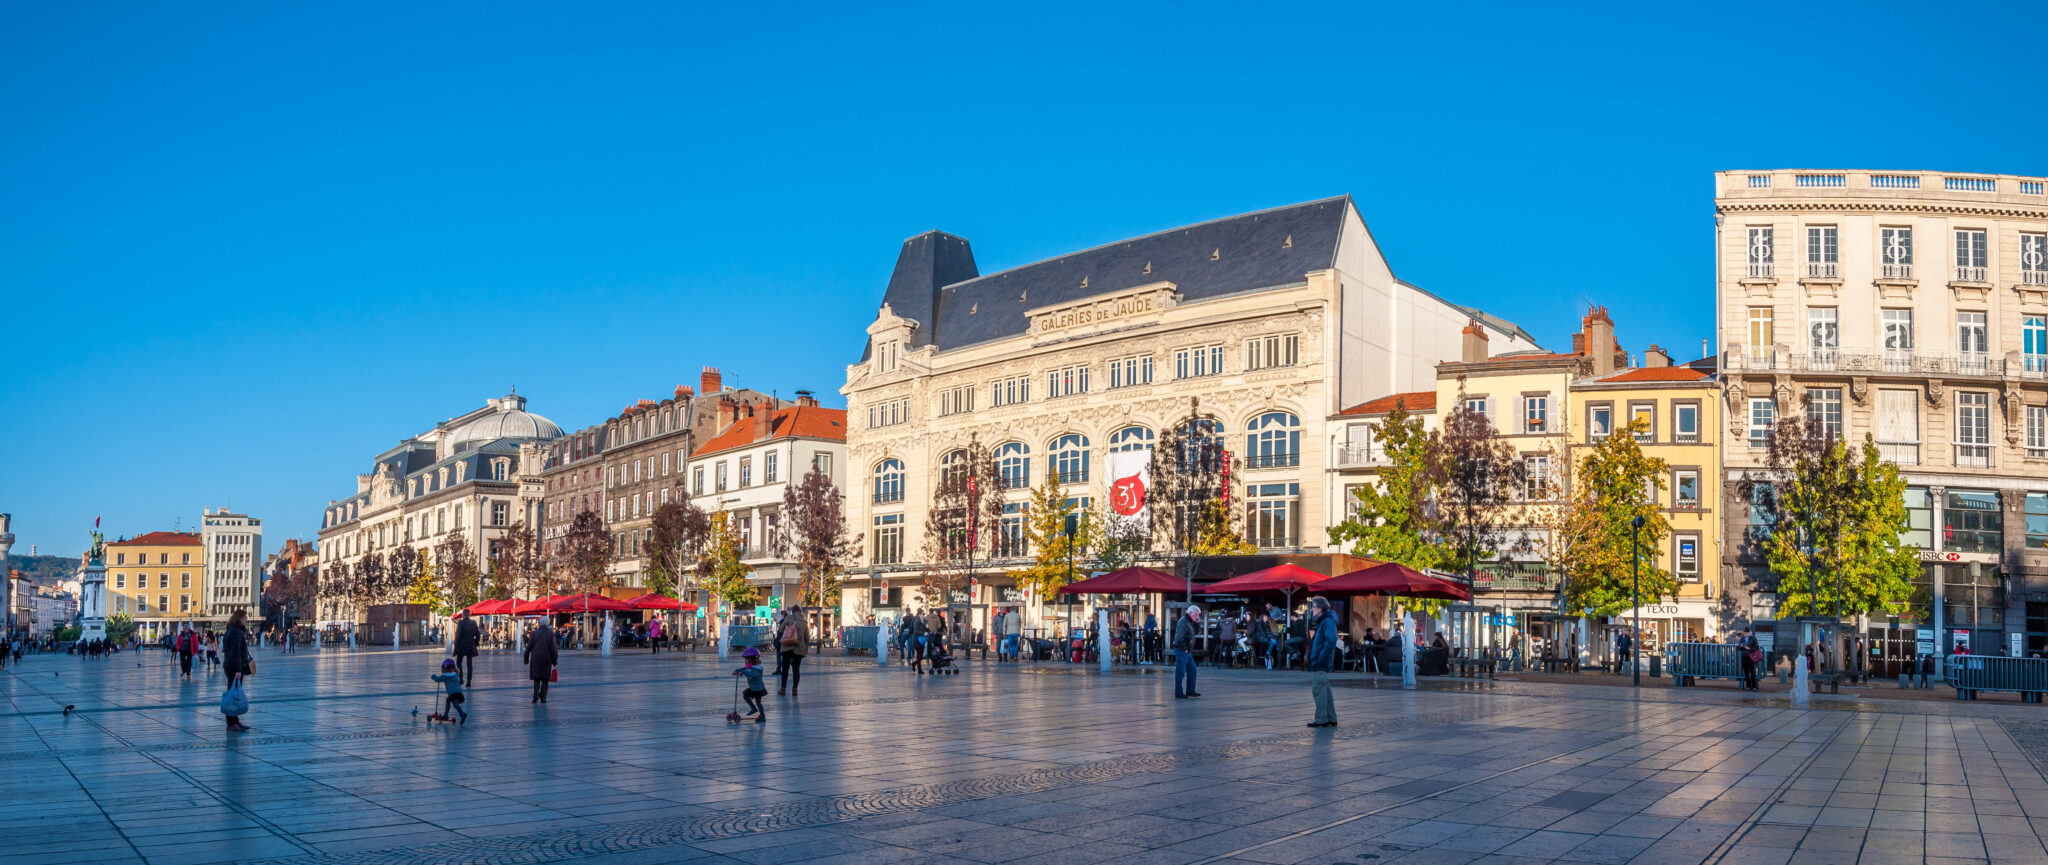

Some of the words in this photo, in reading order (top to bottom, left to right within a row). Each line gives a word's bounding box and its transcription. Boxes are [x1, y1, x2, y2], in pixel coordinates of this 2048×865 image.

[1041, 311, 1092, 331] GALERIES
[1096, 309, 1109, 320] DE
[1113, 298, 1152, 317] JAUDE
[1918, 551, 1945, 561] HSBC
[1646, 605, 1679, 615] TEXTO
